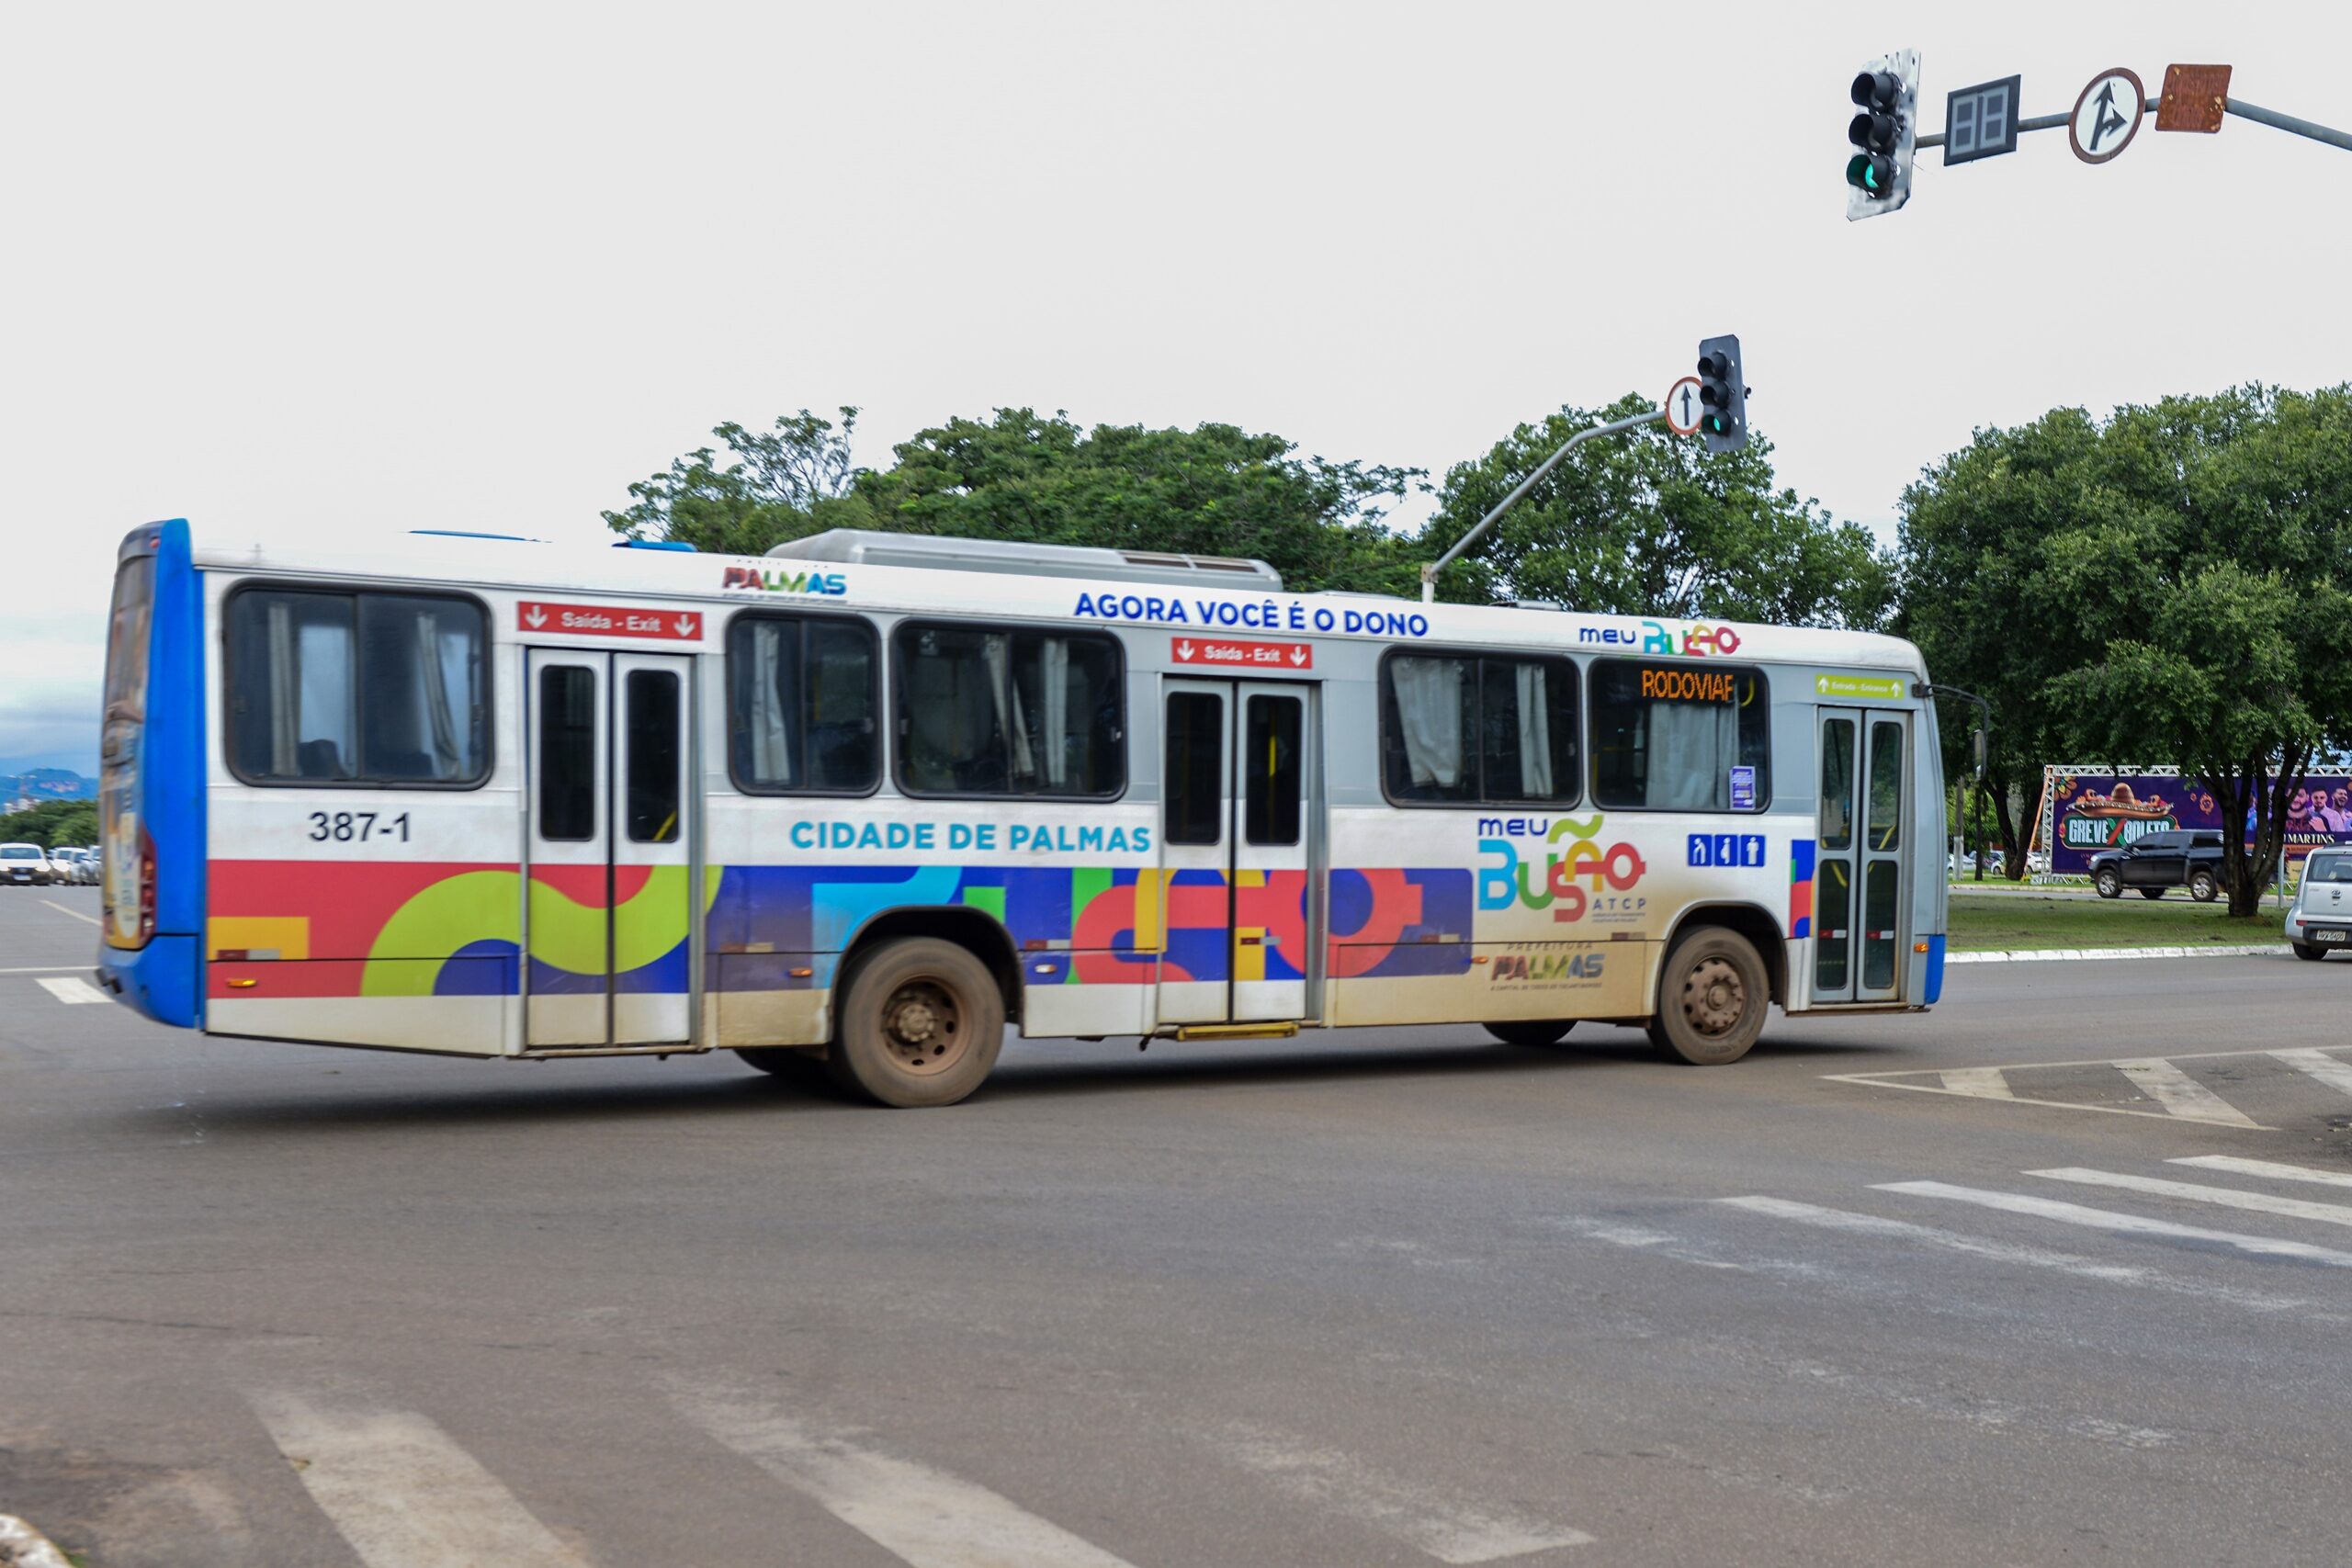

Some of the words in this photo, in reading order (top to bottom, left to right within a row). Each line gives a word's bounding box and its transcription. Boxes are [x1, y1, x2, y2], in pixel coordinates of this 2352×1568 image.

[722, 567, 847, 595] PALMAS
[561, 611, 611, 630] Saída
[627, 616, 662, 632] Exit
[1074, 592, 1188, 623] AGORA
[1197, 599, 1279, 628] VOCÊ
[1289, 602, 1306, 629] É
[1315, 608, 1334, 631] O
[1344, 610, 1428, 637] DONO
[1204, 645, 1242, 661] Saída
[1253, 647, 1280, 663] Exit
[309, 811, 411, 842] 387-1
[789, 821, 934, 849] CIDADE
[949, 823, 996, 850] DE
[1010, 825, 1150, 852] PALMAS
[2069, 819, 2109, 844] GREVE
[2288, 833, 2335, 844] MARTINS
[1490, 953, 1605, 981] PALMAS
